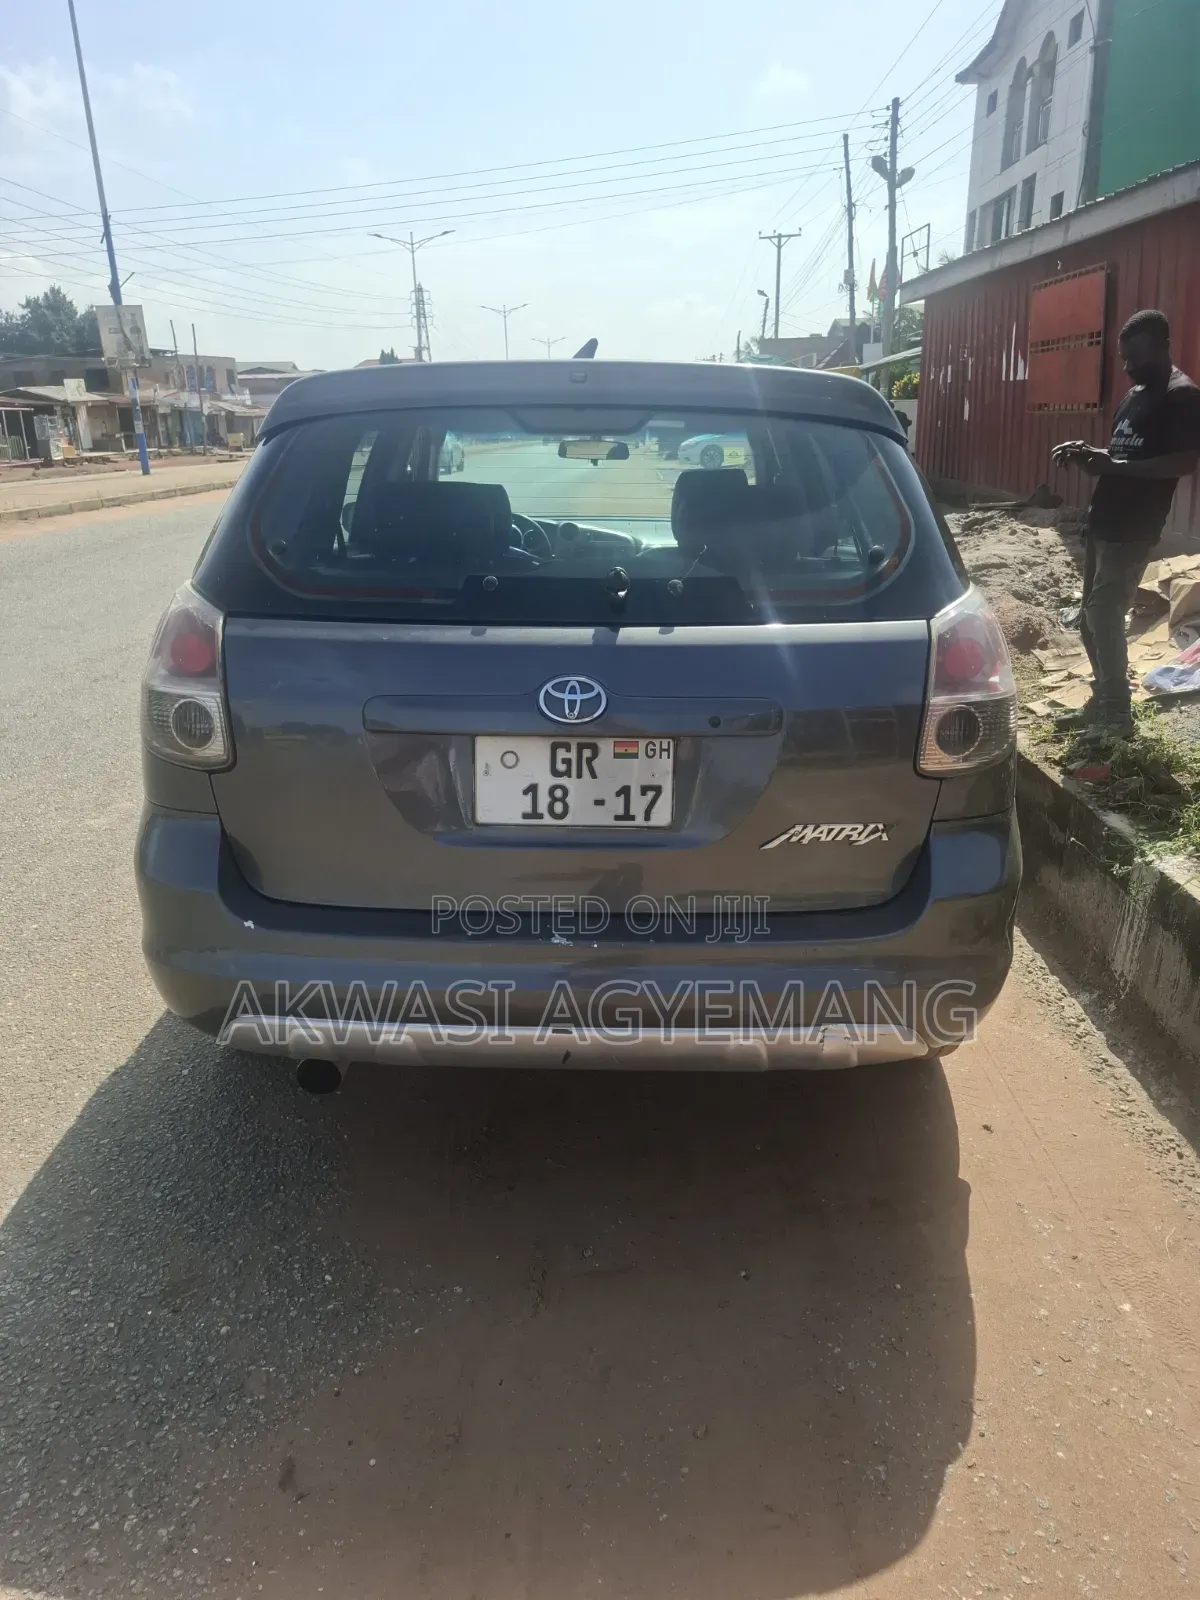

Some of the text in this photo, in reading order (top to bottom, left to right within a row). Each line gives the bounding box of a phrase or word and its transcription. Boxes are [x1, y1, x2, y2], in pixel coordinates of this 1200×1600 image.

[550, 741, 600, 779] GR
[644, 741, 671, 759] GH
[522, 783, 570, 821] 18
